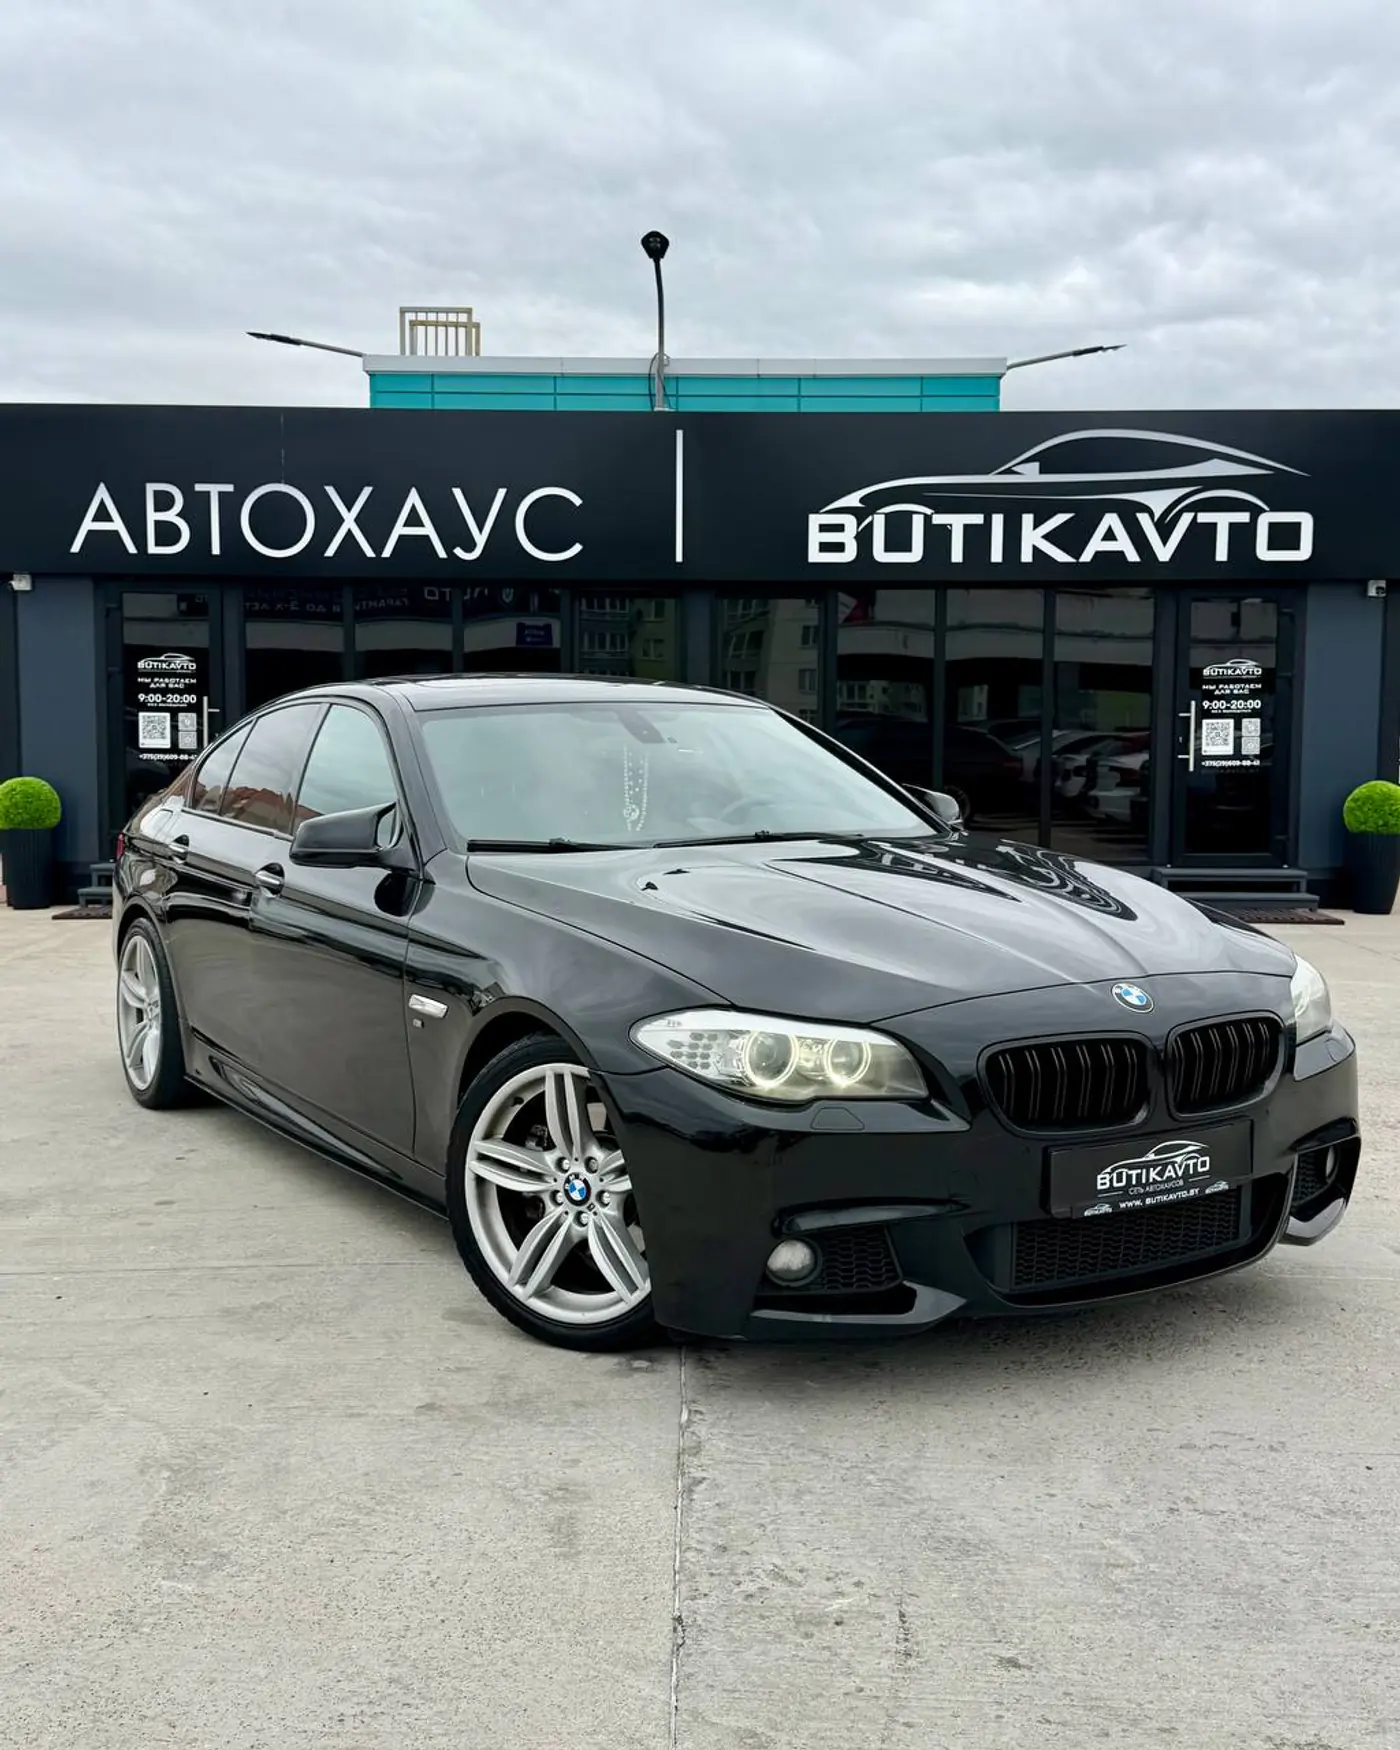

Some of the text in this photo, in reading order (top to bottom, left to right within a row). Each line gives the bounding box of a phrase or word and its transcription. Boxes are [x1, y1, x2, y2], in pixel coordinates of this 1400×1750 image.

[69, 482, 584, 562] АВТОХАУС
[807, 511, 1314, 564] BUTIKAVTO
[137, 661, 197, 670] BUTIKAVTO
[1202, 667, 1262, 676] BUTIKAVTO
[138, 693, 197, 703] 9:00-20:00
[1202, 700, 1262, 709] 9:00-20:00
[1096, 1156, 1210, 1190] BUTIKAVTO
